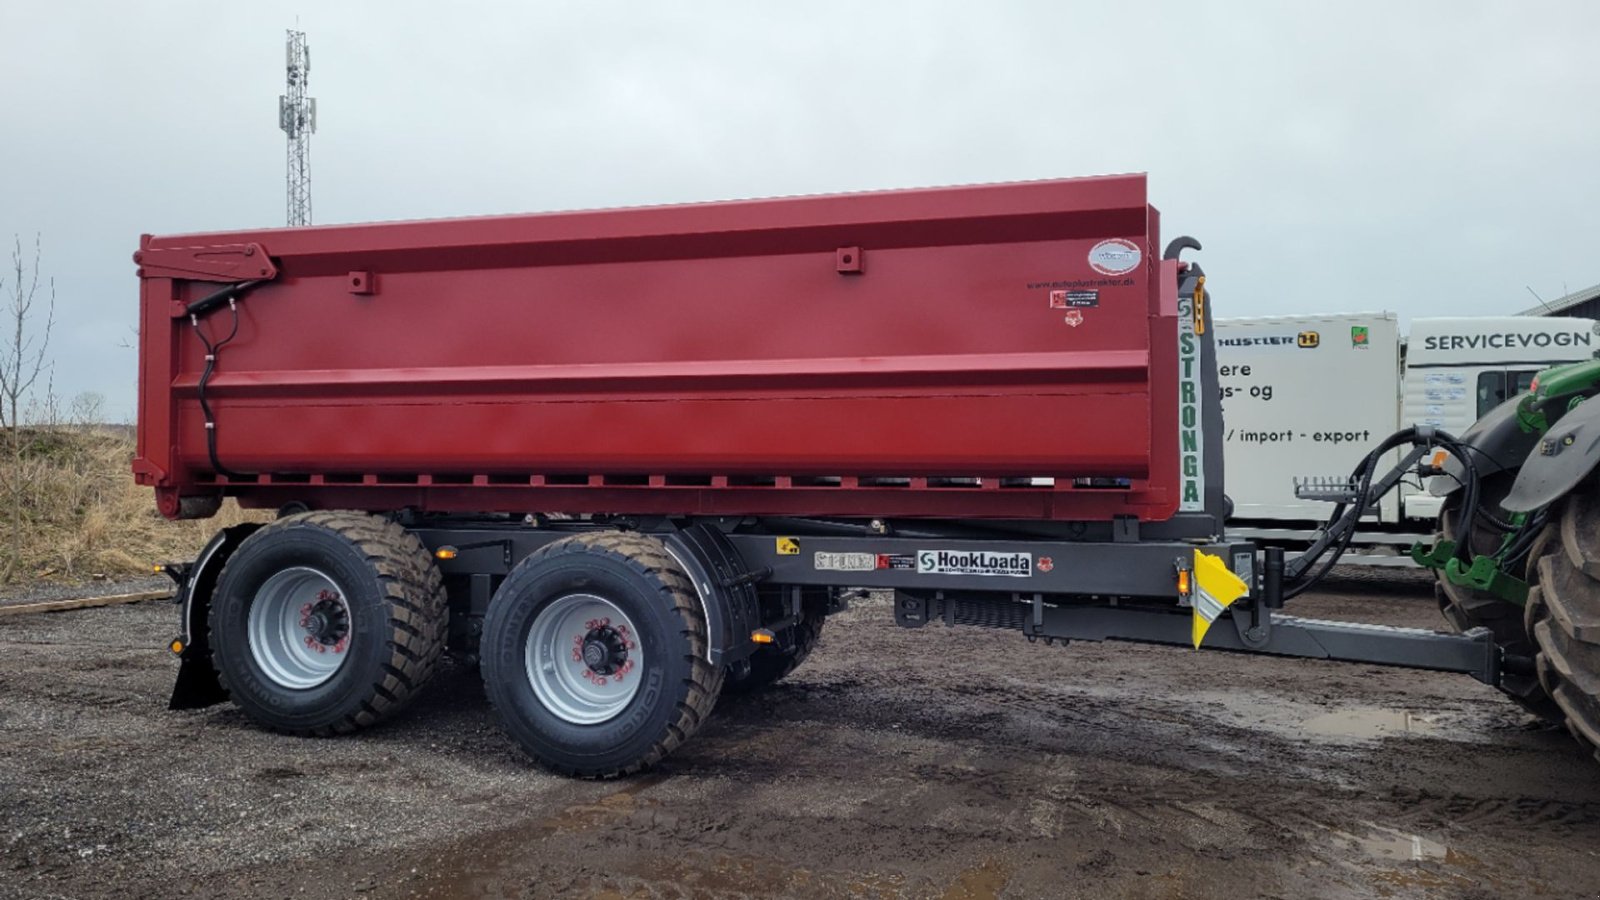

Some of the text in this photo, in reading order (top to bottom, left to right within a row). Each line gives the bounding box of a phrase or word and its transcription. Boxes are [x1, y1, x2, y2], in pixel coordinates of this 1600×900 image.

[1218, 337, 1294, 346] HUSTLER
[1425, 332, 1590, 350] SERVICEVOGN
[1250, 386, 1272, 401] og
[1180, 332, 1199, 502] STRONGA
[1240, 429, 1293, 444] import
[1313, 430, 1370, 444] export
[938, 552, 1030, 569] HookLoada
